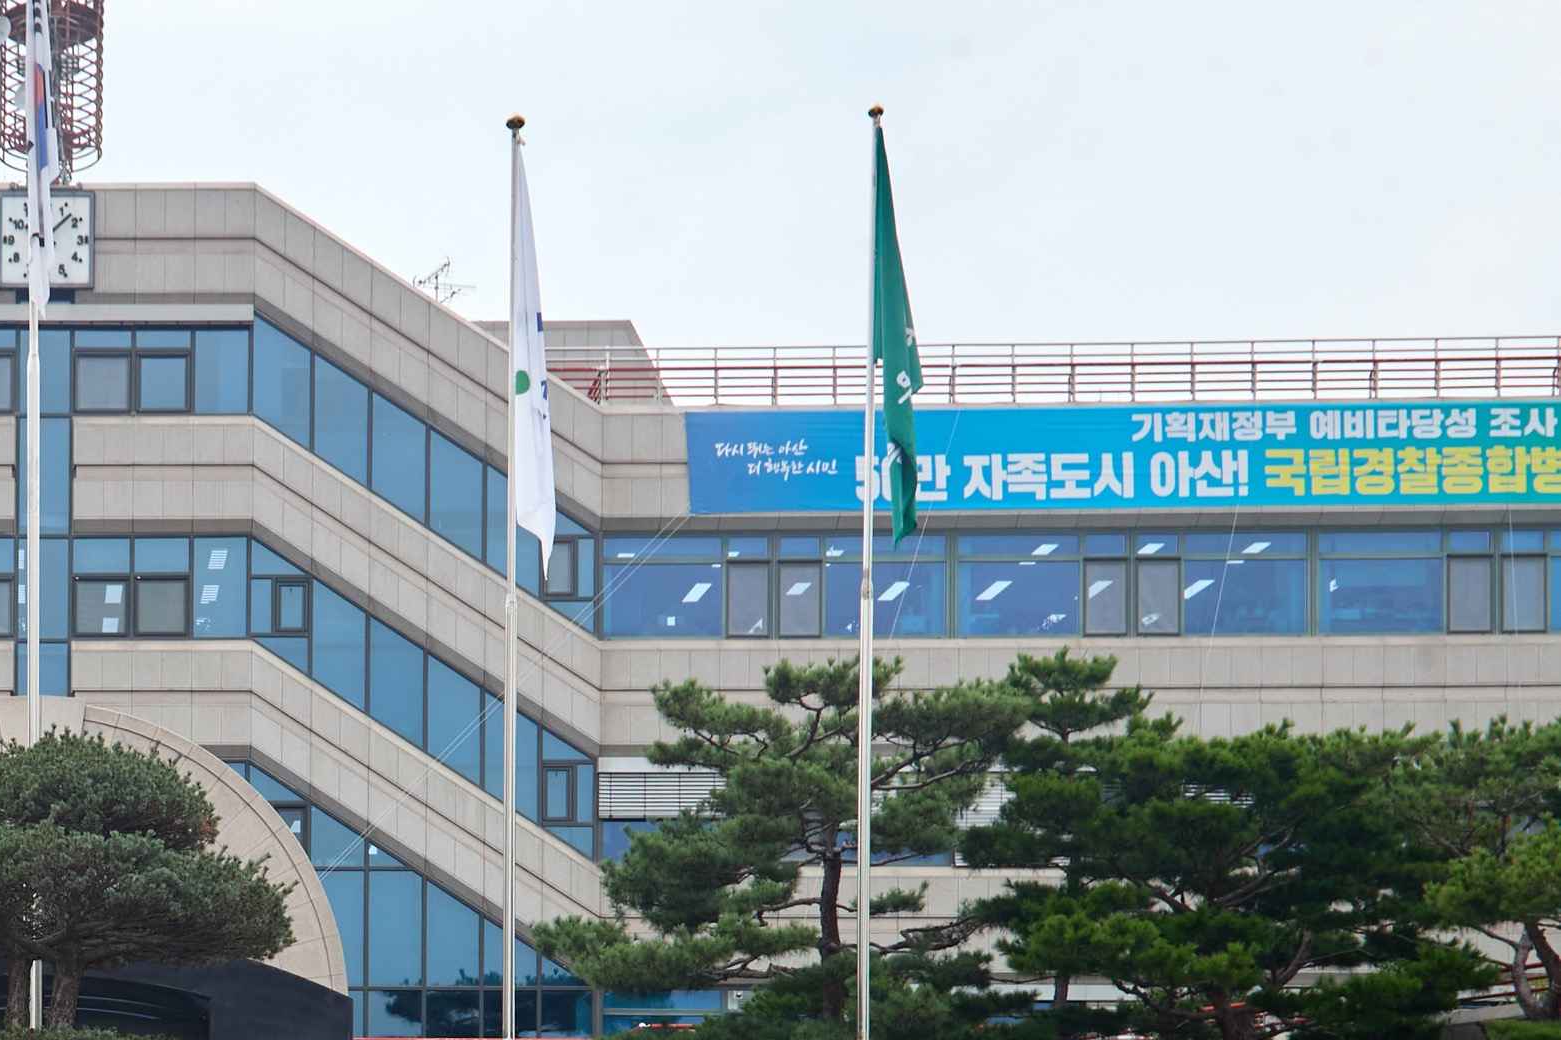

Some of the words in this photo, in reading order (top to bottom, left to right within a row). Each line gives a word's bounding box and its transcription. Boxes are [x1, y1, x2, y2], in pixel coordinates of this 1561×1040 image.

[59, 207, 64, 216] 1
[13, 219, 24, 230] 10
[71, 218, 79, 228] 2
[8, 235, 15, 245] 9
[77, 235, 84, 246] 3
[13, 252, 20, 263] 8
[71, 252, 79, 262] 4
[58, 264, 65, 275] 5
[1131, 410, 1297, 442] 기획재정부
[1309, 408, 1478, 441] 예비타당성
[1489, 407, 1558, 439] 조사
[715, 443, 744, 458] 다시
[779, 438, 808, 456] 아산
[747, 460, 760, 475] 더
[806, 458, 838, 475] 시민
[962, 451, 1135, 501] 자족도시
[1150, 449, 1249, 498] 아산!
